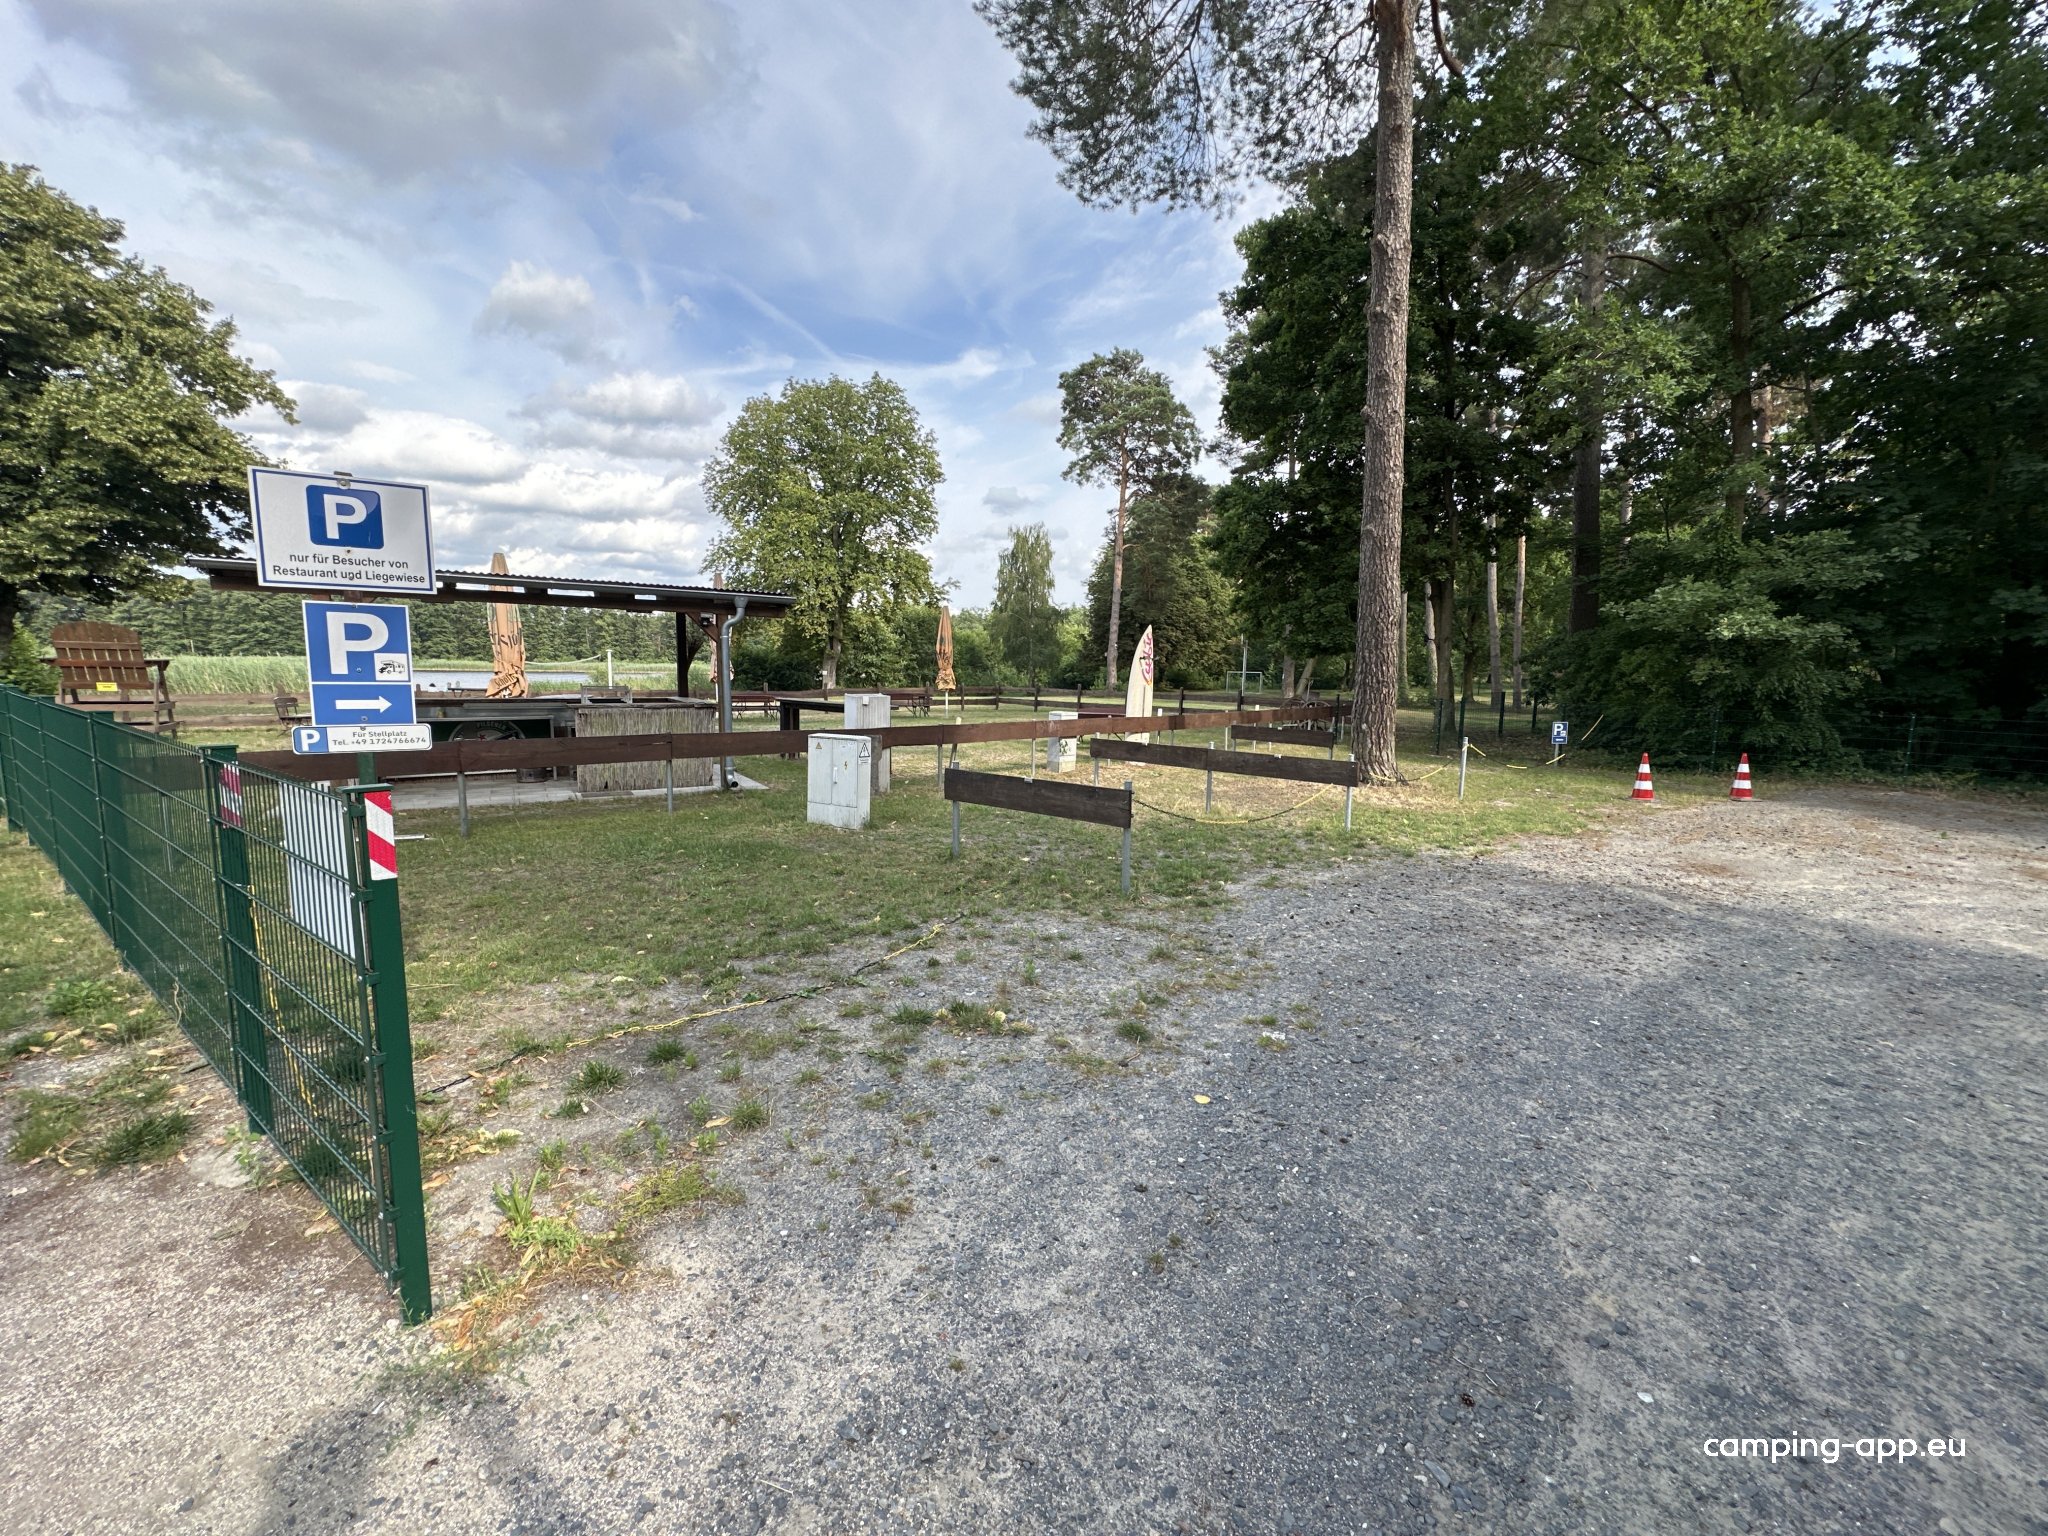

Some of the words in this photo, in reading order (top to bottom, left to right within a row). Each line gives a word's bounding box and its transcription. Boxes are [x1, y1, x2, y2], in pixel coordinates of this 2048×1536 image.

[323, 494, 367, 539] P
[290, 553, 309, 562] nur
[313, 554, 329, 564] für
[332, 555, 386, 567] Besucher
[389, 560, 408, 569] von
[273, 565, 337, 578] Restaurant
[341, 571, 362, 580] und
[365, 571, 425, 583] Liegewiese
[326, 611, 389, 675] P
[368, 730, 407, 738] Stellplatz
[1554, 724, 1563, 735] P
[300, 729, 321, 751] P
